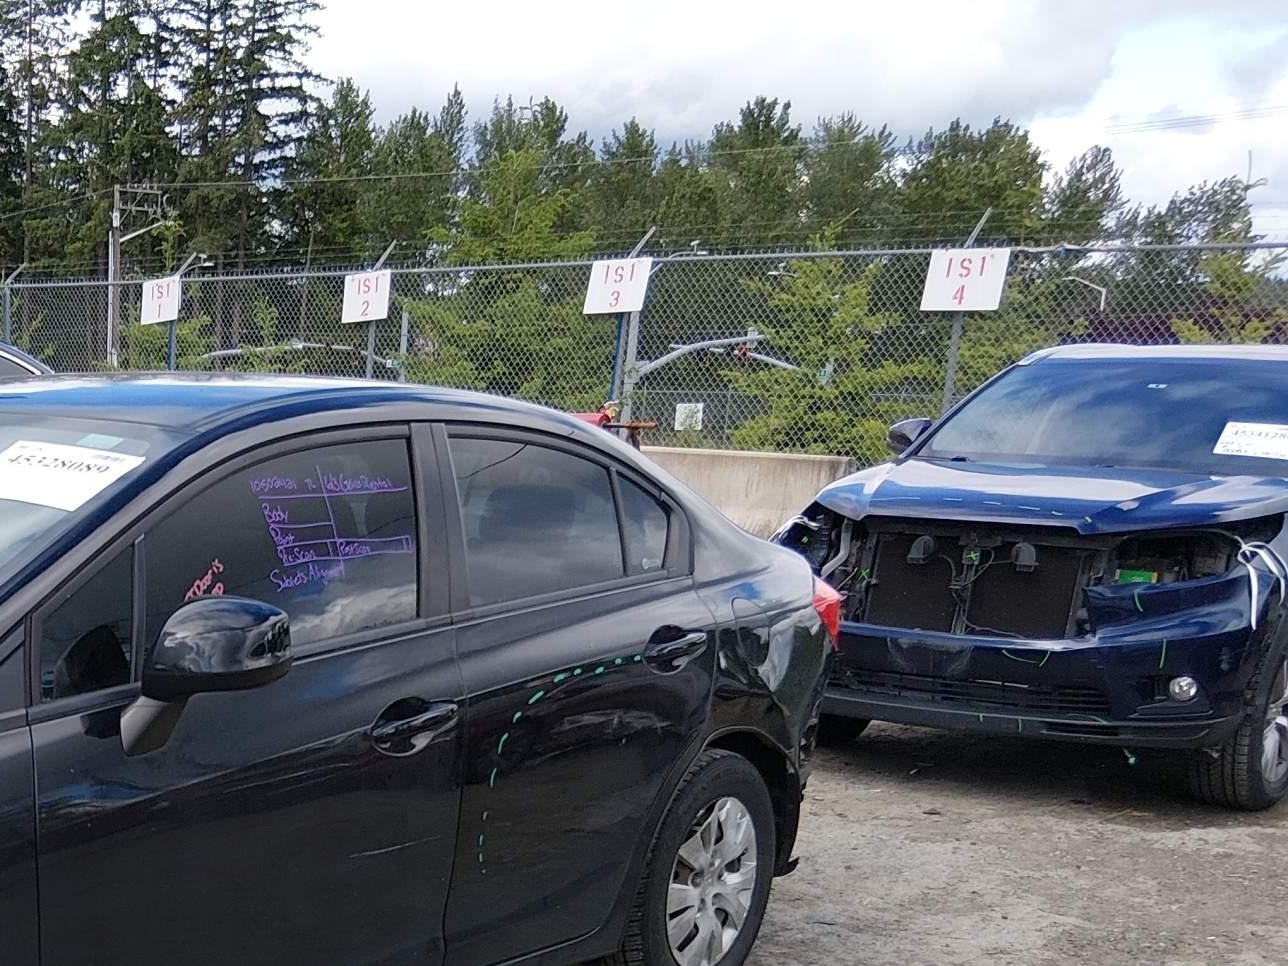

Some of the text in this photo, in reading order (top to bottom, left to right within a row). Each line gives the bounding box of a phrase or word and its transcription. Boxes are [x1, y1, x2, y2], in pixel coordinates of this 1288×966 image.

[609, 290, 621, 308] 3
[952, 284, 965, 305] 4
[360, 299, 370, 317] 2
[262, 503, 288, 523] Body
